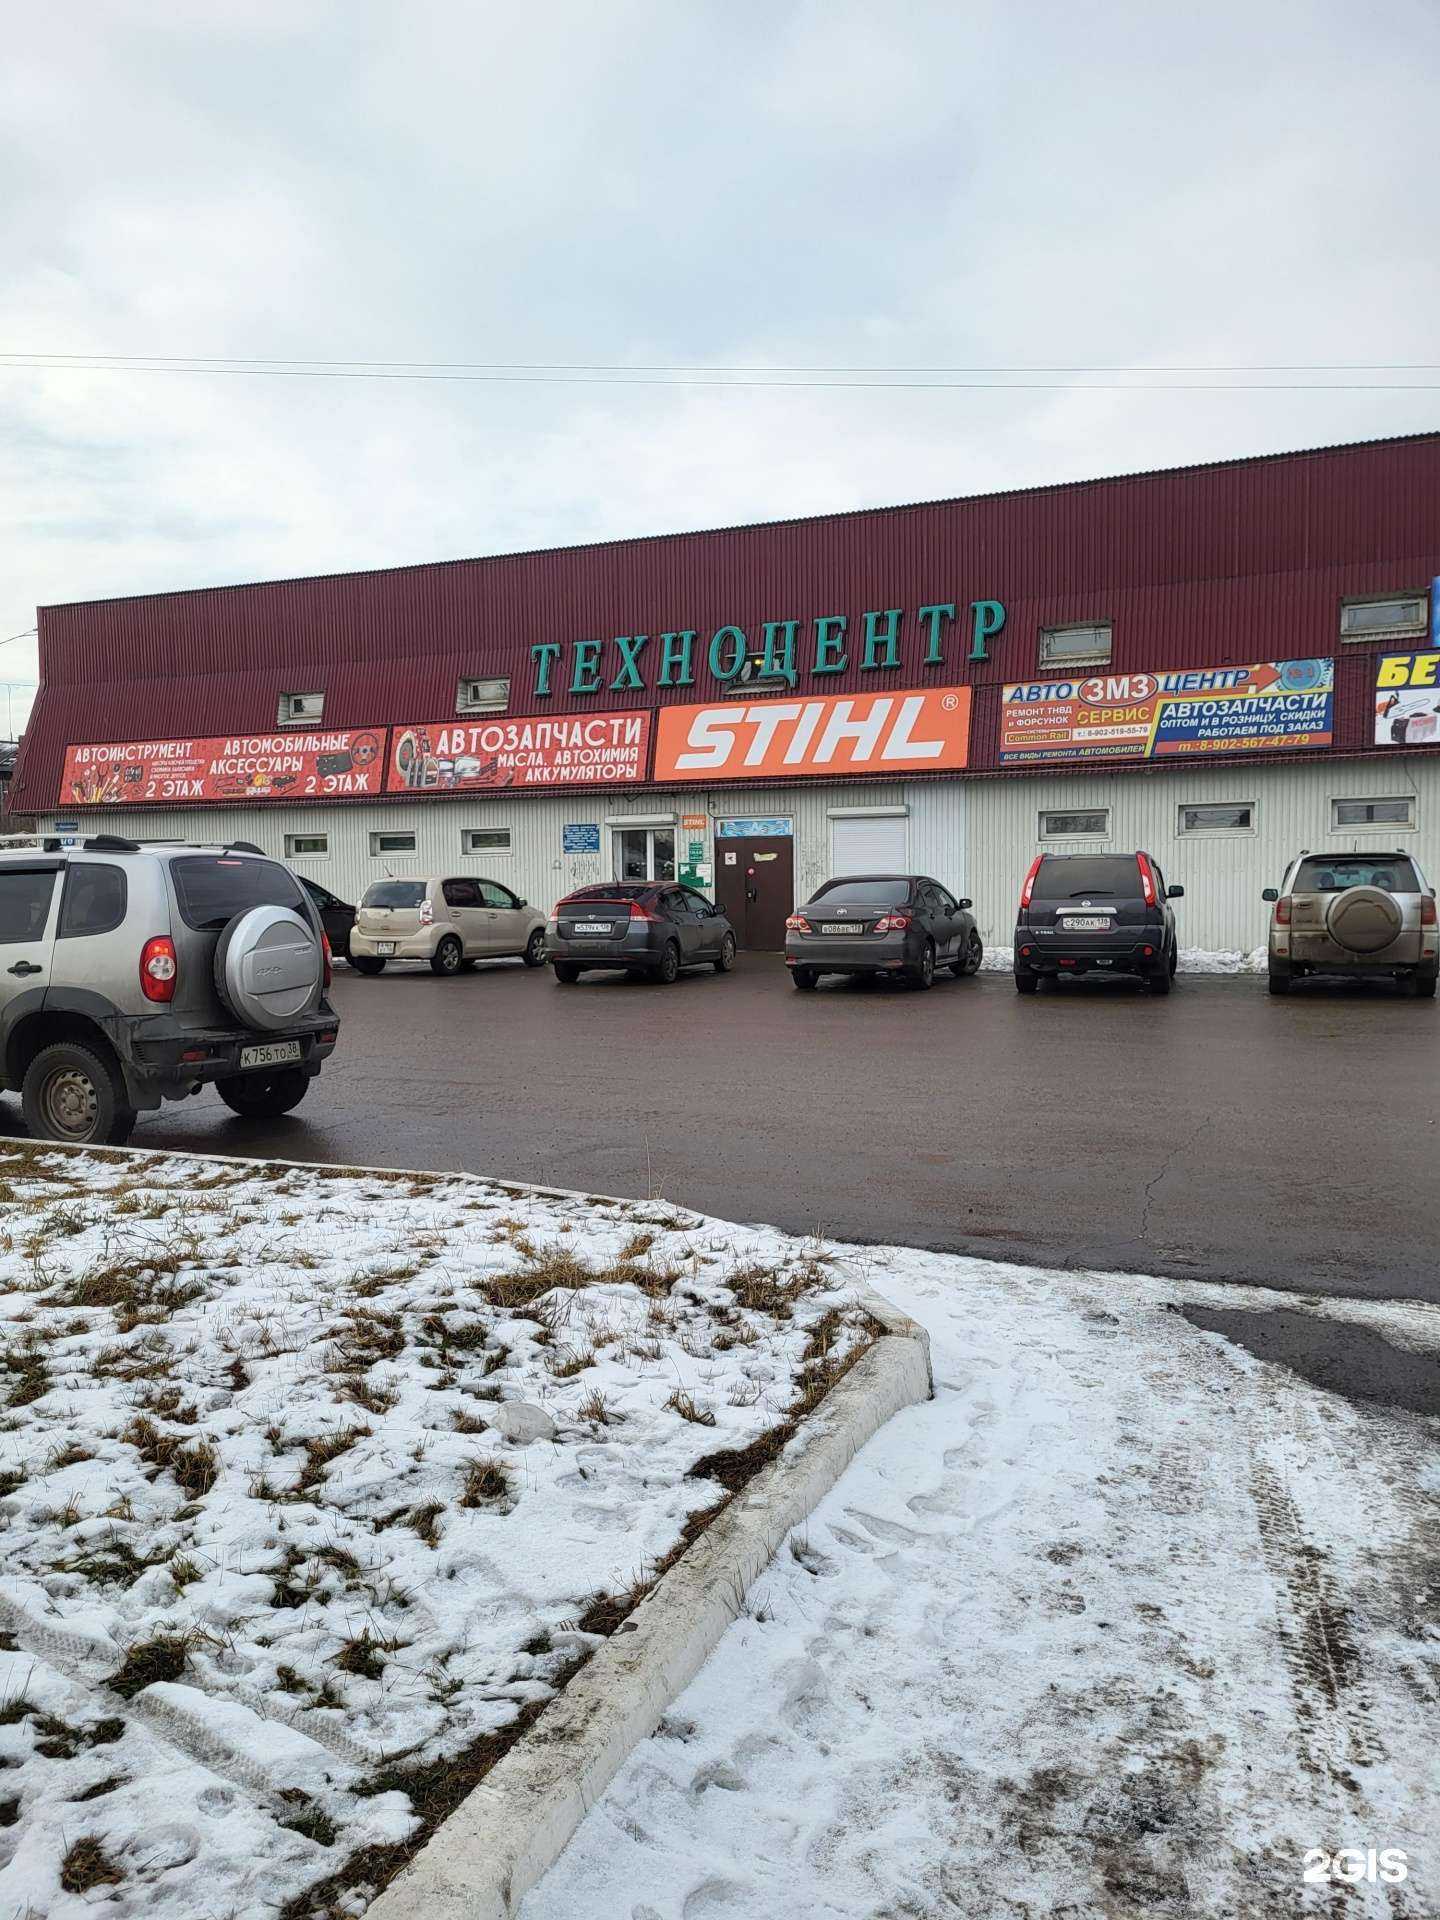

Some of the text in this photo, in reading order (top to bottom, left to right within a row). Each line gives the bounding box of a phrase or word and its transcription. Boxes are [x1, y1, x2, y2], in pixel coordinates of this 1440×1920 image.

[531, 600, 1006, 696] ТЕХНОЦЕНТР
[1163, 669, 1251, 696] ЦЕНТР
[1009, 683, 1073, 703] АВТО
[1006, 705, 1073, 717] РЕМОНТ ТНВД
[1163, 693, 1327, 718] АВТОЗАПЧАСТИ
[1016, 715, 1069, 727] ФОРСУНОК
[1077, 707, 1150, 725] СЕРВИС
[1160, 718, 1199, 728] ОПТОМ
[1200, 717, 1210, 726] И
[1211, 717, 1220, 726] В
[1280, 709, 1326, 721] СКИДКИ
[436, 717, 642, 754] АВТОЗАПЧАСТИ
[674, 696, 946, 769] STIHL
[1008, 732, 1067, 742] Common Rail
[1197, 720, 1324, 737] РАБОТАЕМ ПОД ЗАКАЗ
[75, 742, 193, 763] АВТОИНСТРУМЕНТ
[224, 734, 350, 756] АВТОМОБИЛЬНЫЕ
[1042, 750, 1077, 758] РЕМОНТА
[1078, 743, 1145, 756] АВТОМОБИЛЕЙ
[209, 756, 304, 775] АКСЕССУАРЫ
[554, 747, 638, 765] АВТОХИМИЯ
[525, 764, 637, 782] АККУМУЛЯТОРЫ
[145, 780, 204, 797] 2 ЭТАЖ
[305, 773, 369, 793] 2 ЭТАЖ
